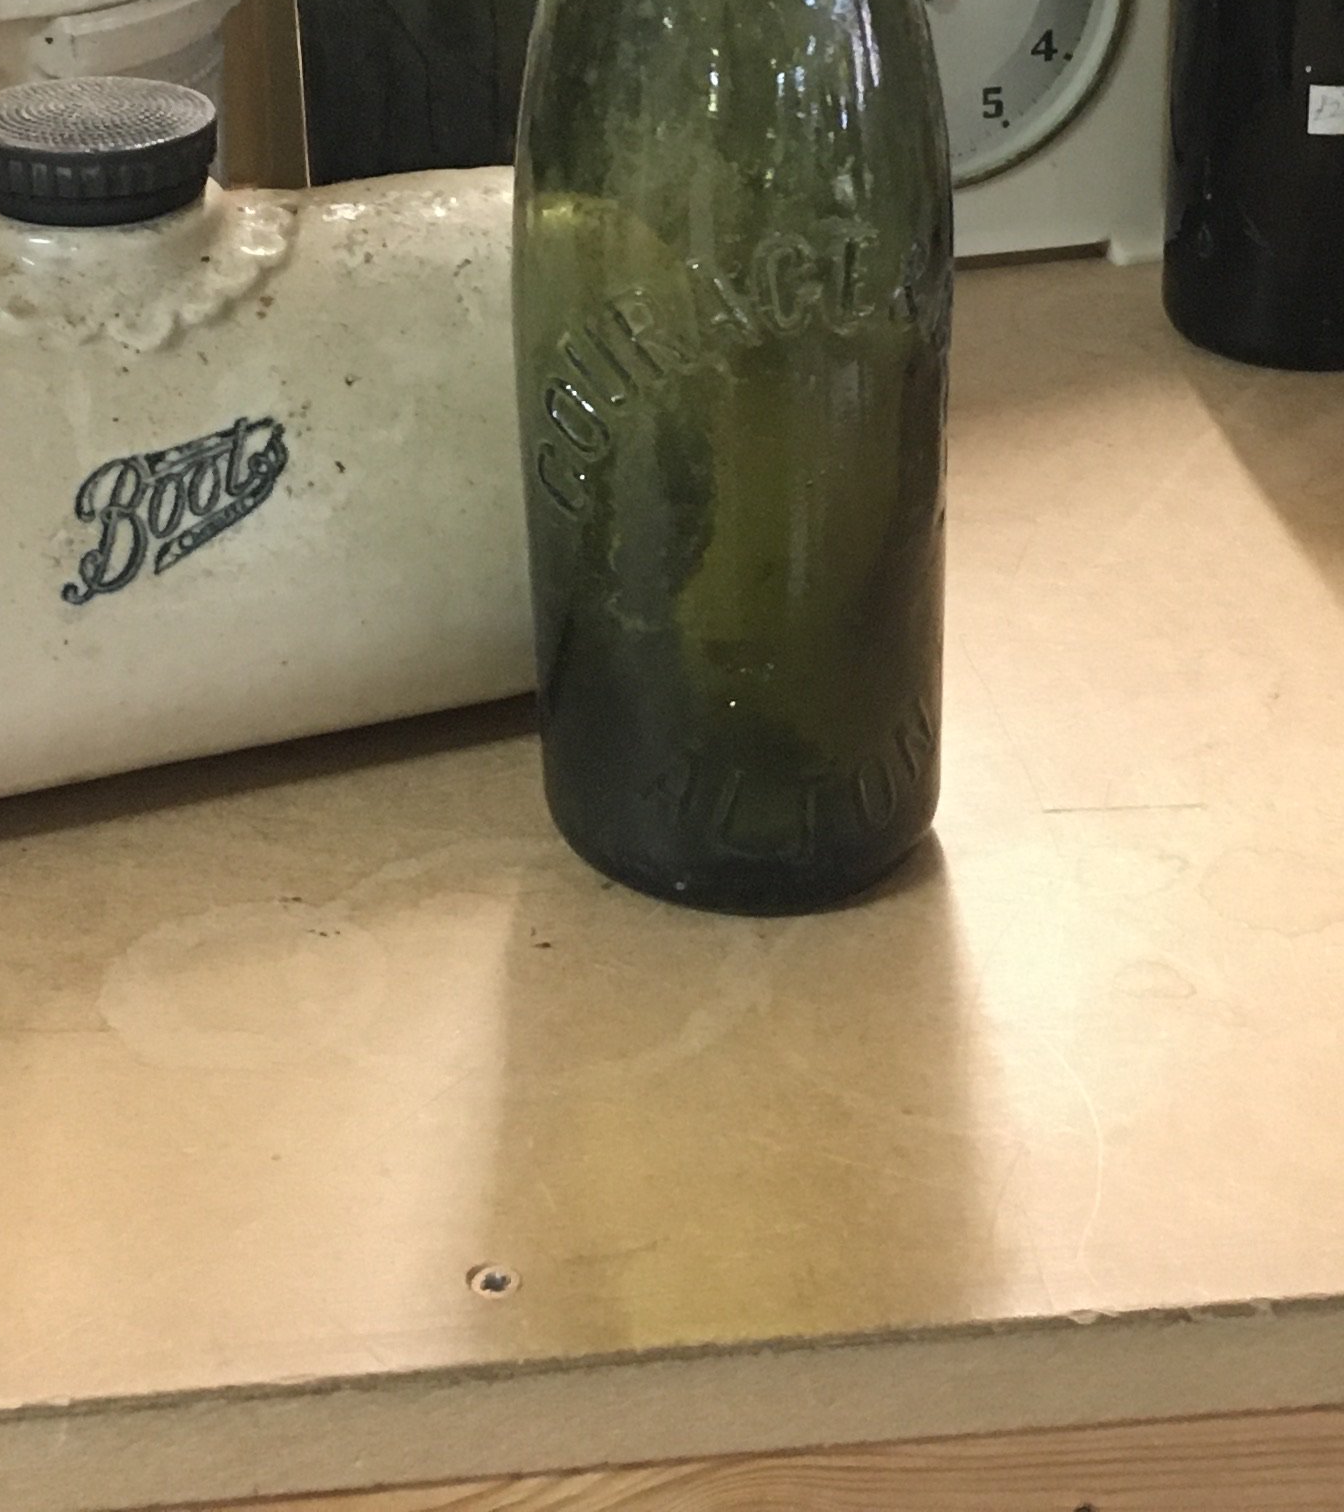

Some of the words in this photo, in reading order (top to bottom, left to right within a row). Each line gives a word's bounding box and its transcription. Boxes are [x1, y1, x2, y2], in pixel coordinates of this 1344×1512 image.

[1030, 30, 1058, 62] 4
[982, 87, 1004, 119] 5
[535, 216, 880, 520] COURAGE
[61, 415, 288, 606] Boots
